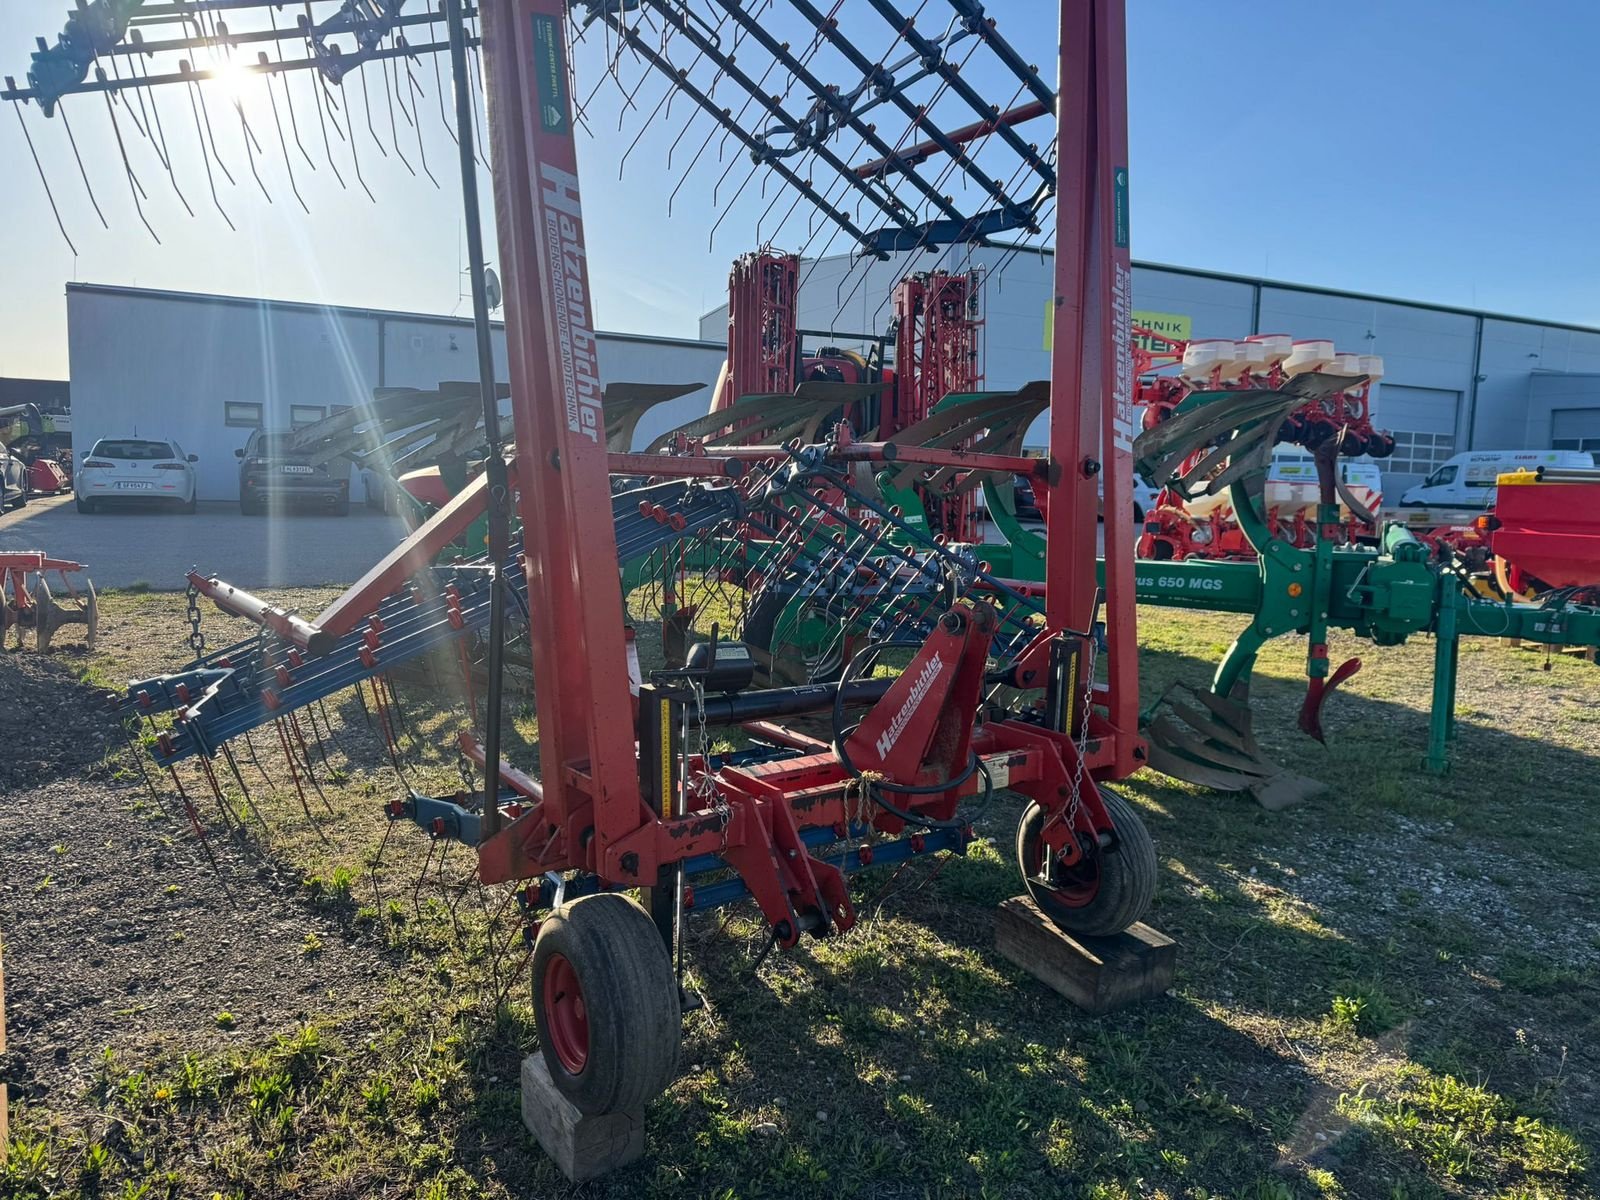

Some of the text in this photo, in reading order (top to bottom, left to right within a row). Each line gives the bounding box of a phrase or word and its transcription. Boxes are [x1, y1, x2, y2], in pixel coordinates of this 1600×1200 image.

[540, 161, 602, 443] Hatzenbichler
[547, 218, 578, 423] BODENSCHONENDE LANDTECHNIK
[1112, 263, 1132, 453] Hatzenbichler
[1158, 576, 1185, 588] 650
[1188, 578, 1223, 590] MGS
[876, 650, 941, 761] Hatzenbichler
